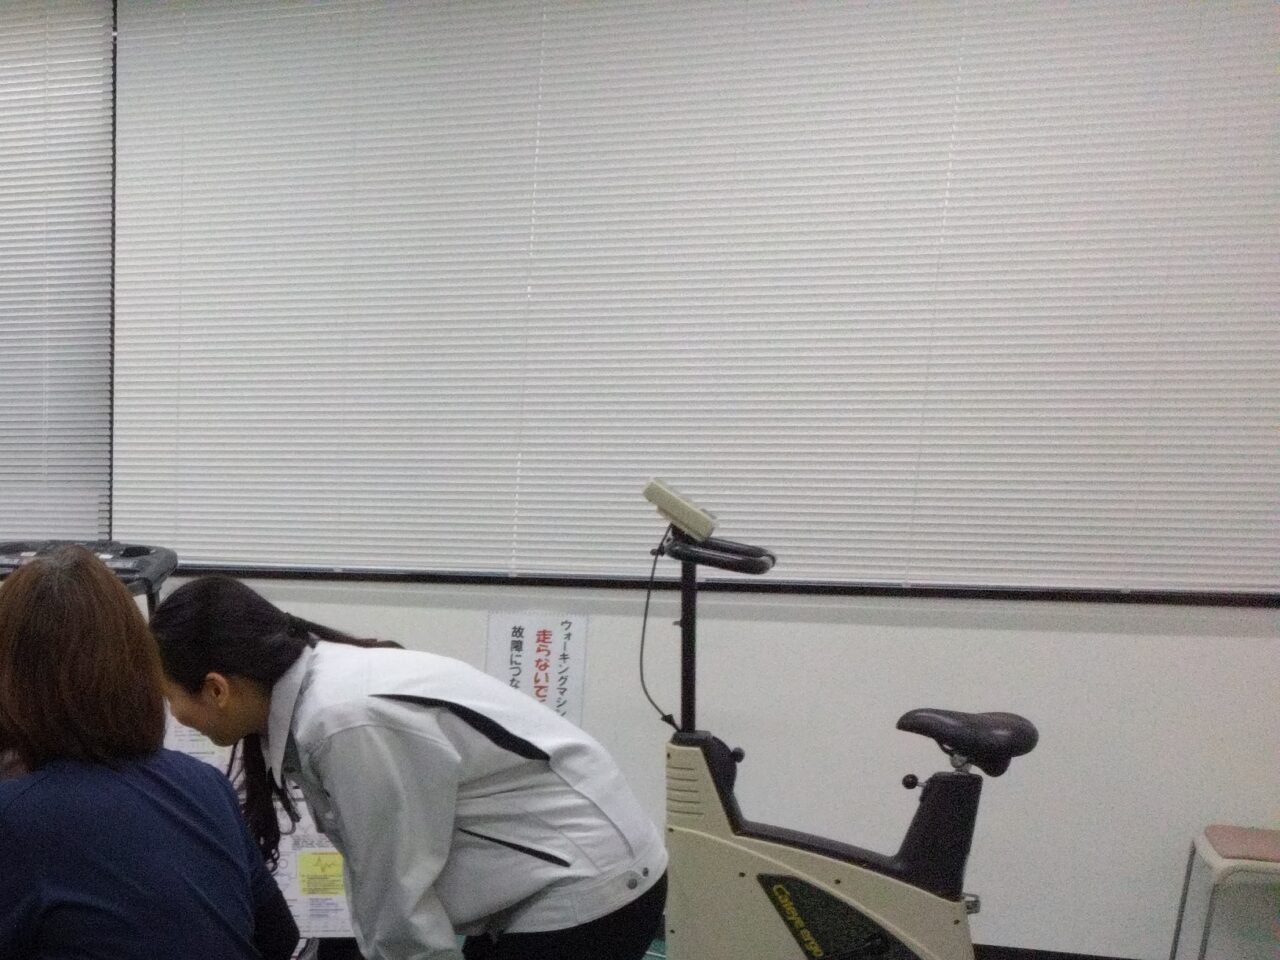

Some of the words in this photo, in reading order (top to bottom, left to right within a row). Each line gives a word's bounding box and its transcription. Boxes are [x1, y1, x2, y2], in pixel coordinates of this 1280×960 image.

[533, 629, 553, 703] 走らないで
